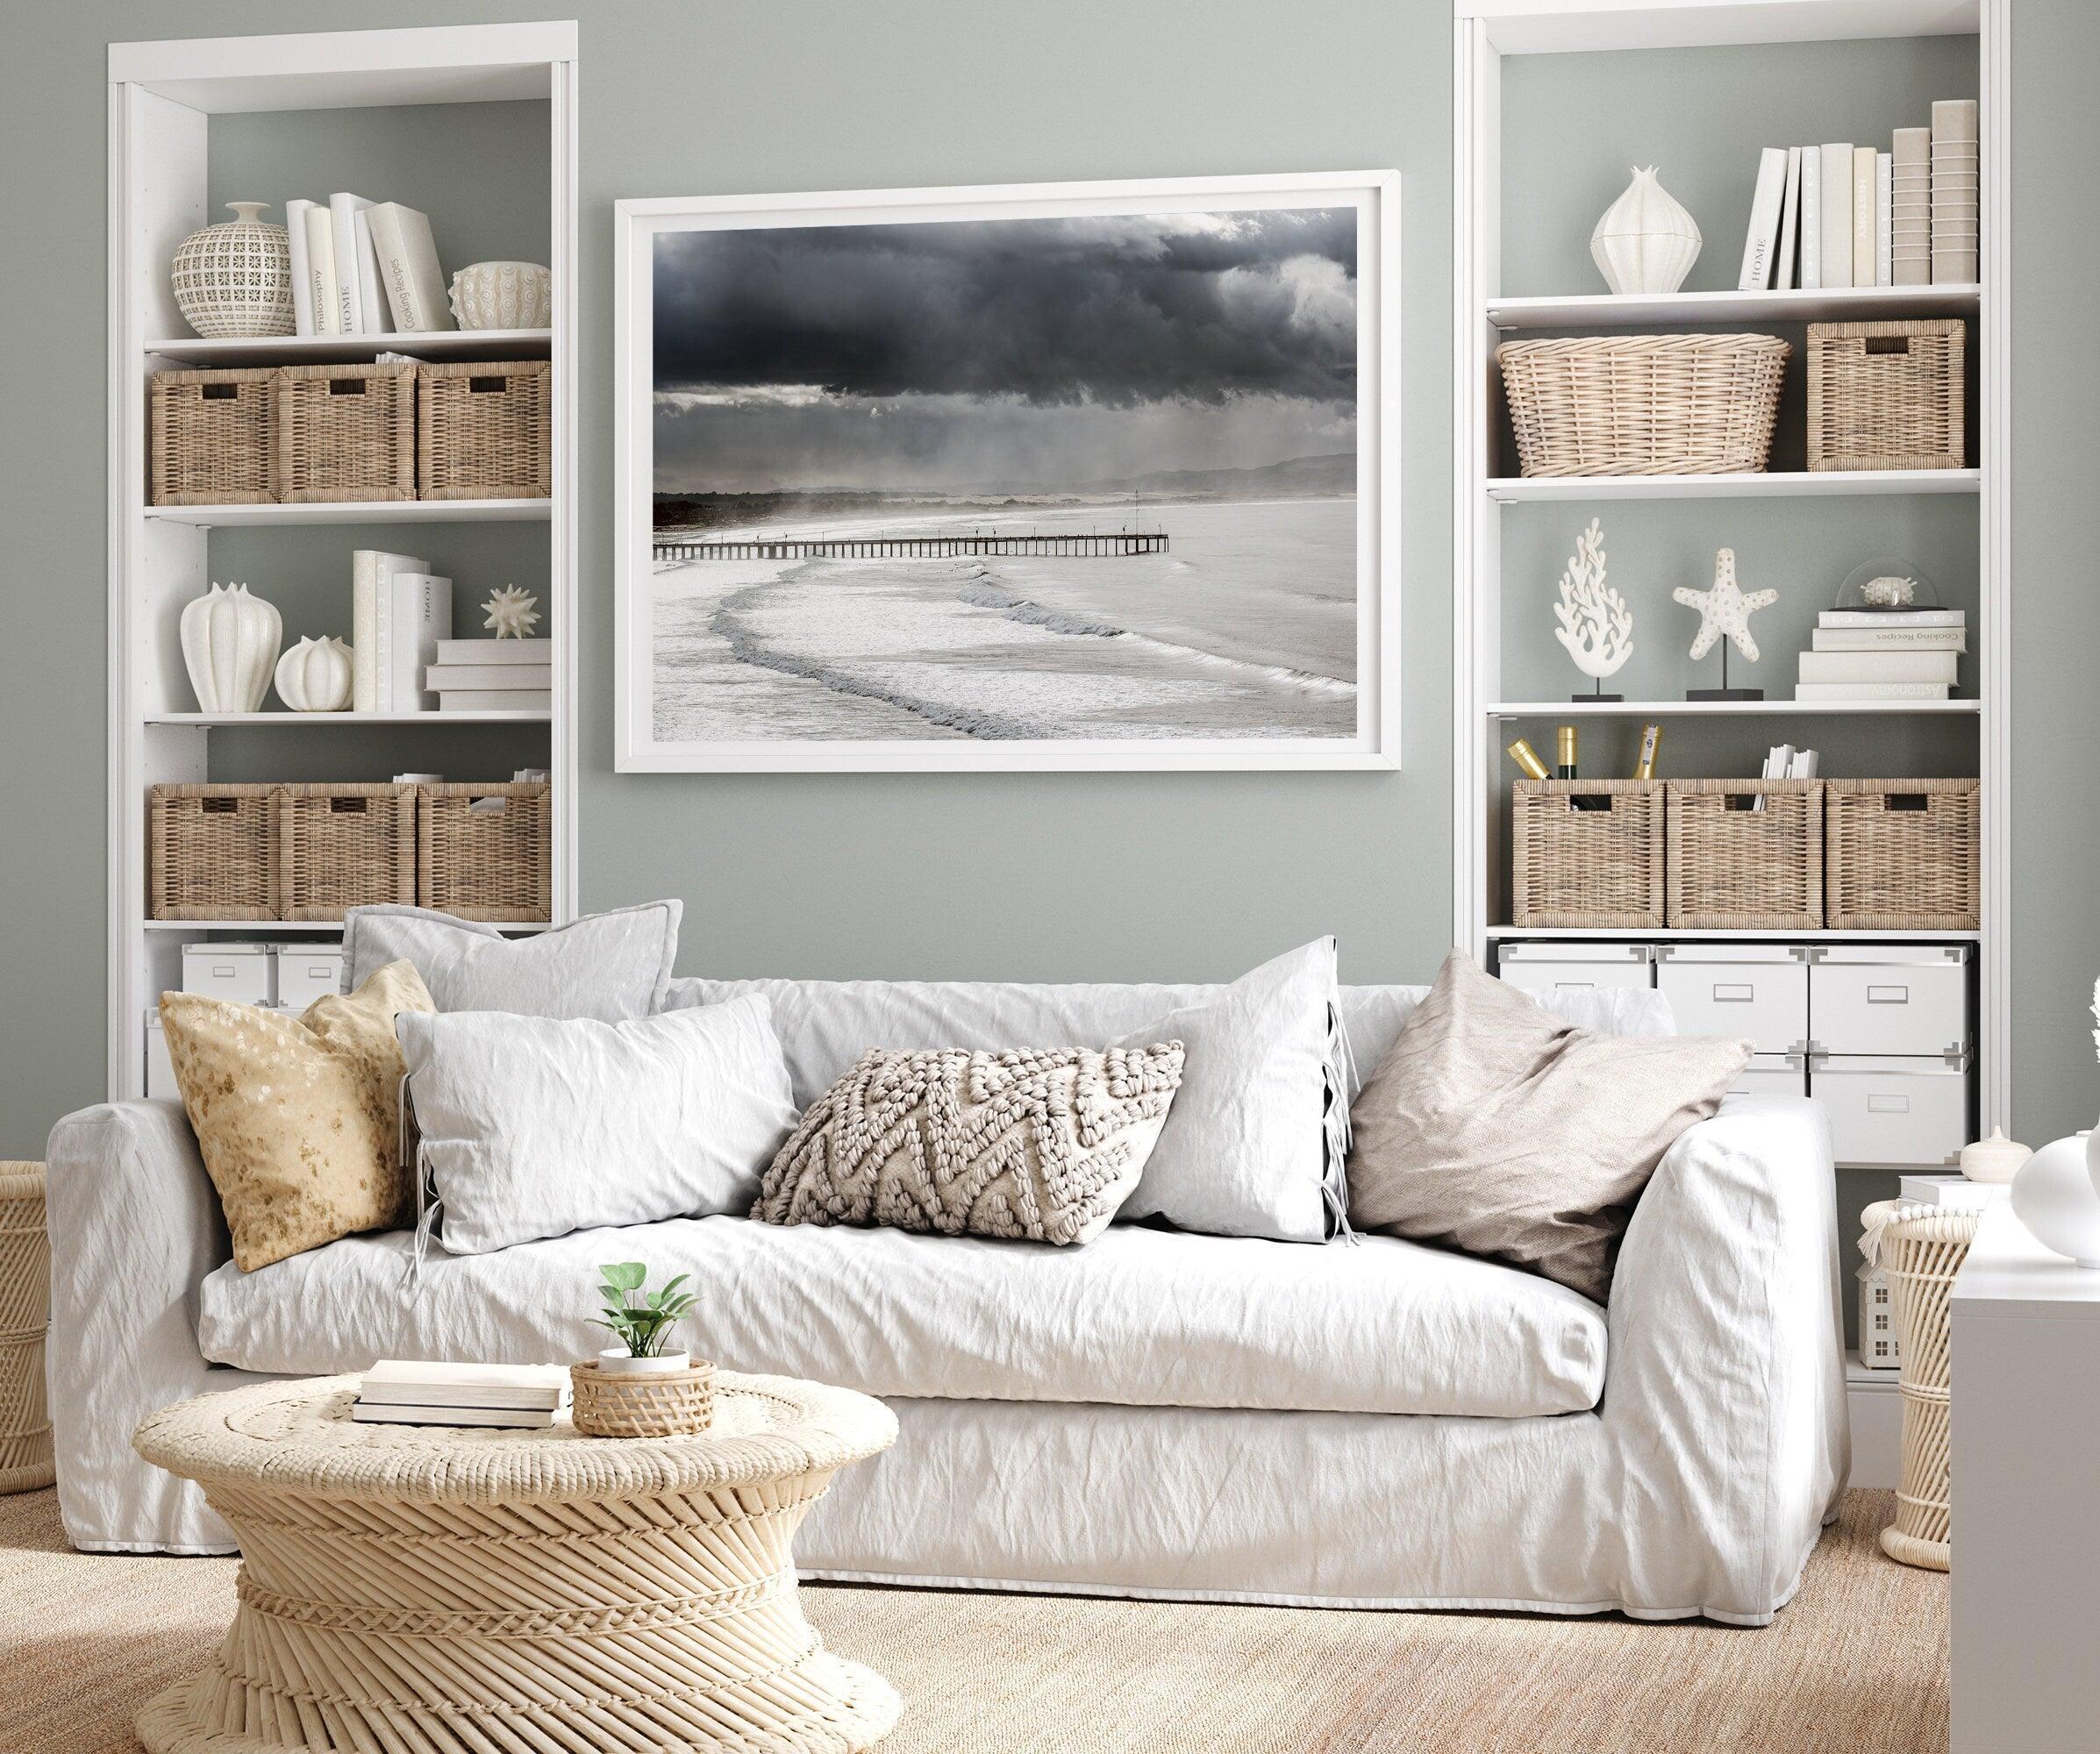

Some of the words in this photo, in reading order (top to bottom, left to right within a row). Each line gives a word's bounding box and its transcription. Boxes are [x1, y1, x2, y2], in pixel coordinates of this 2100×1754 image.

[1858, 179, 1868, 239] HISTORY
[389, 258, 405, 293] Recipes
[1751, 239, 1767, 282] HOME
[314, 269, 325, 332] Philosophy
[341, 286, 353, 332] HOME
[399, 292, 416, 330] Cooking
[1875, 631, 1915, 641] Recipes
[1917, 631, 1959, 641] Cooking
